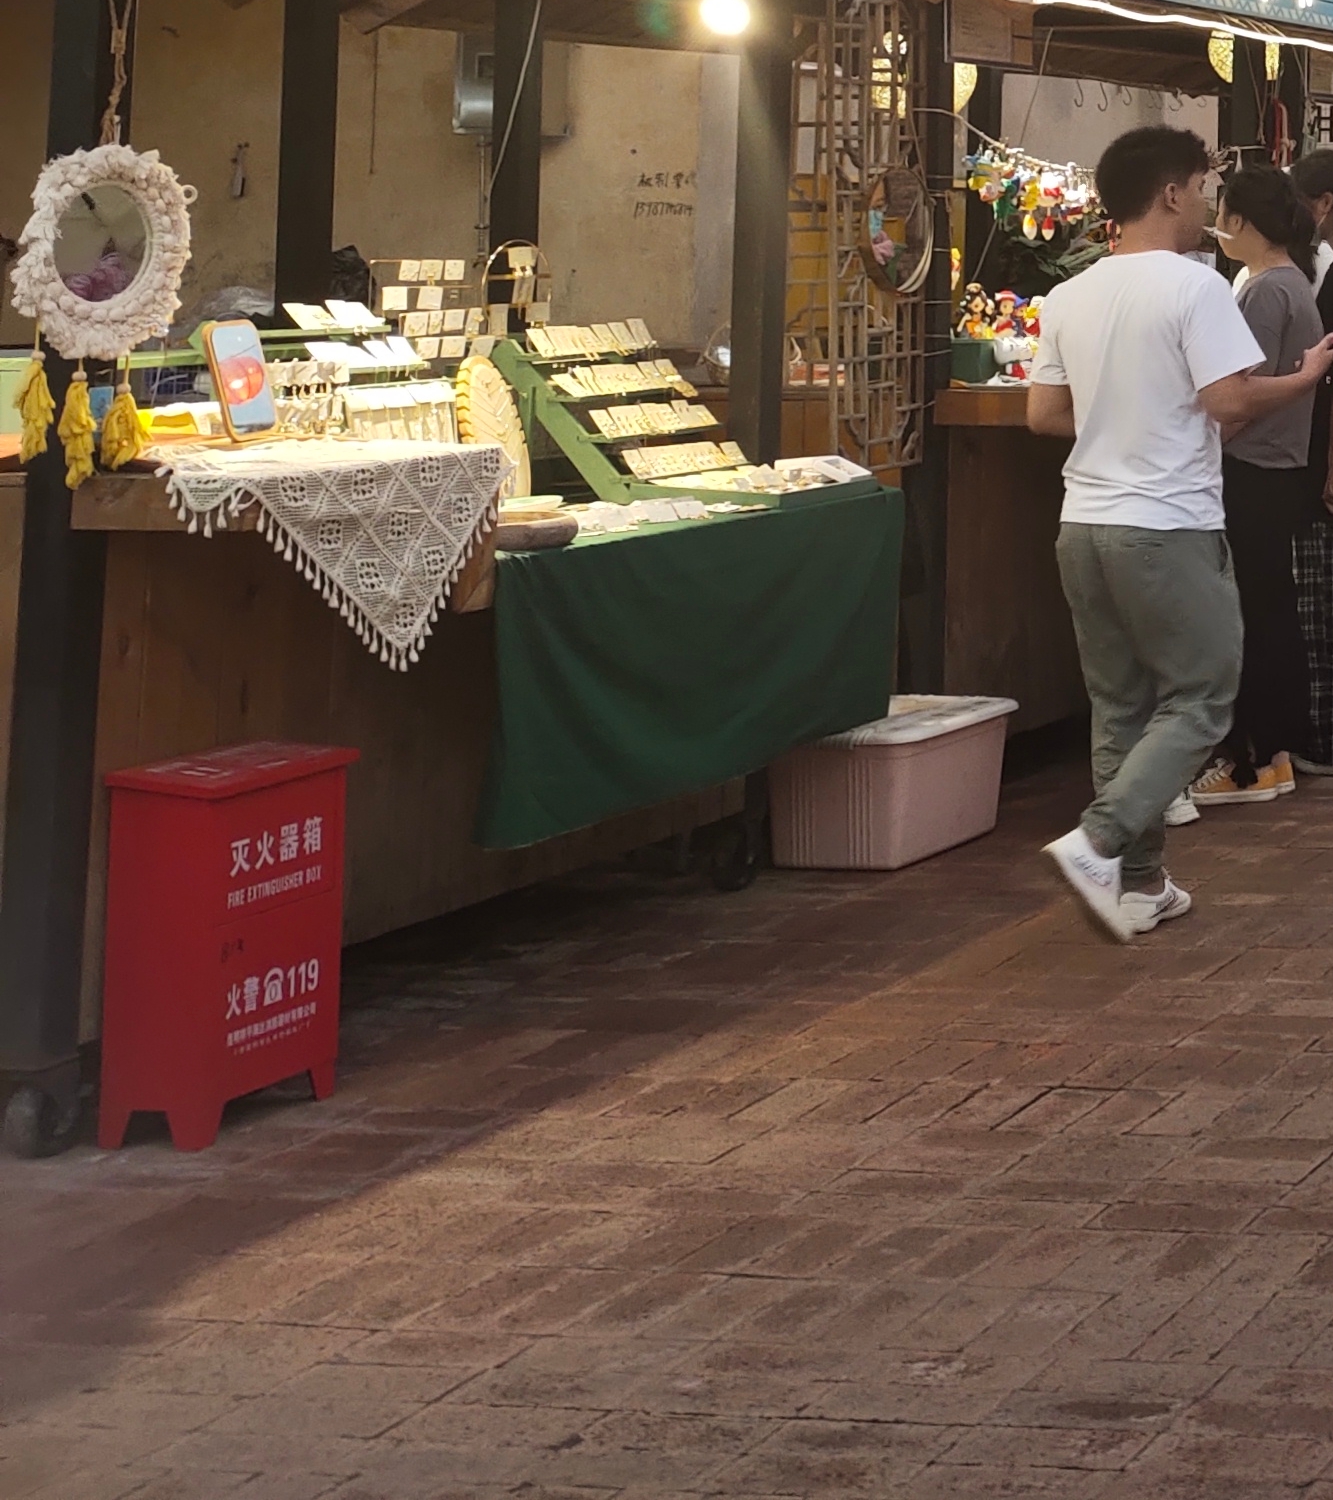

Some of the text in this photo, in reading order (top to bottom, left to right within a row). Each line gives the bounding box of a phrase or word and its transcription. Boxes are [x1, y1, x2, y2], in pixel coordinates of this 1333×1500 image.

[229, 815, 323, 878] 灭火器箱
[227, 865, 322, 910] FIRE EXTINGUISHER BOX
[225, 958, 319, 1020] 火警 119
